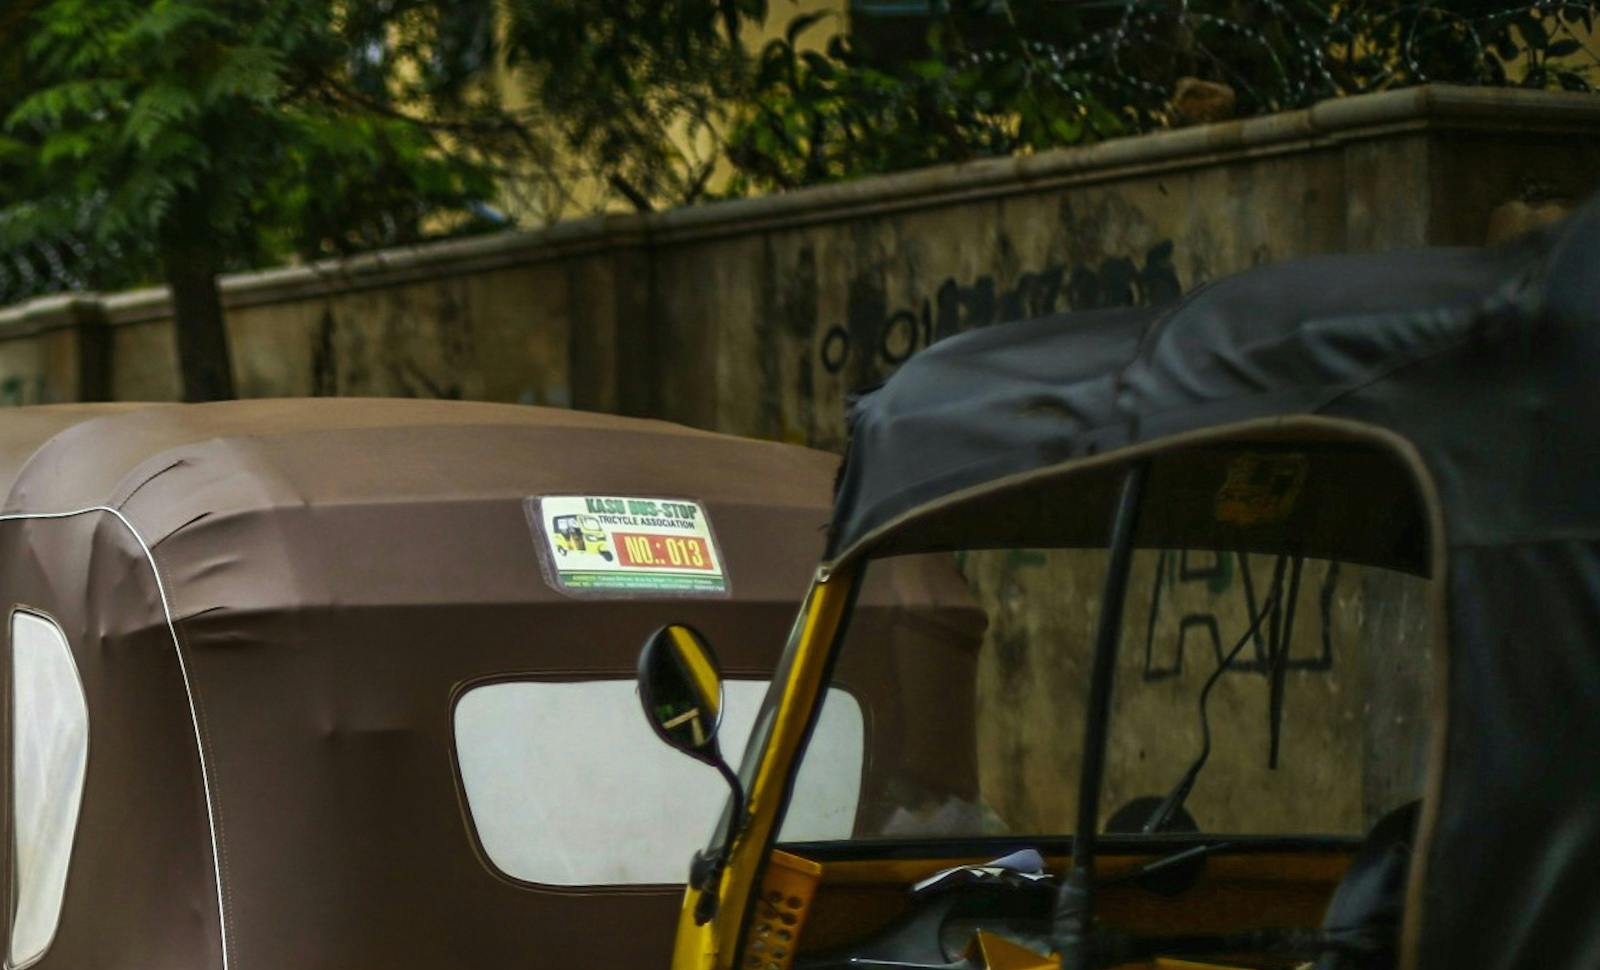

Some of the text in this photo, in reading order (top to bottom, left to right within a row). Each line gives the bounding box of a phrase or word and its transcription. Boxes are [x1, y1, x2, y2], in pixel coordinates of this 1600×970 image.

[598, 515, 696, 529] TRICYCLE ASSOCIATION
[665, 538, 704, 567] 013
